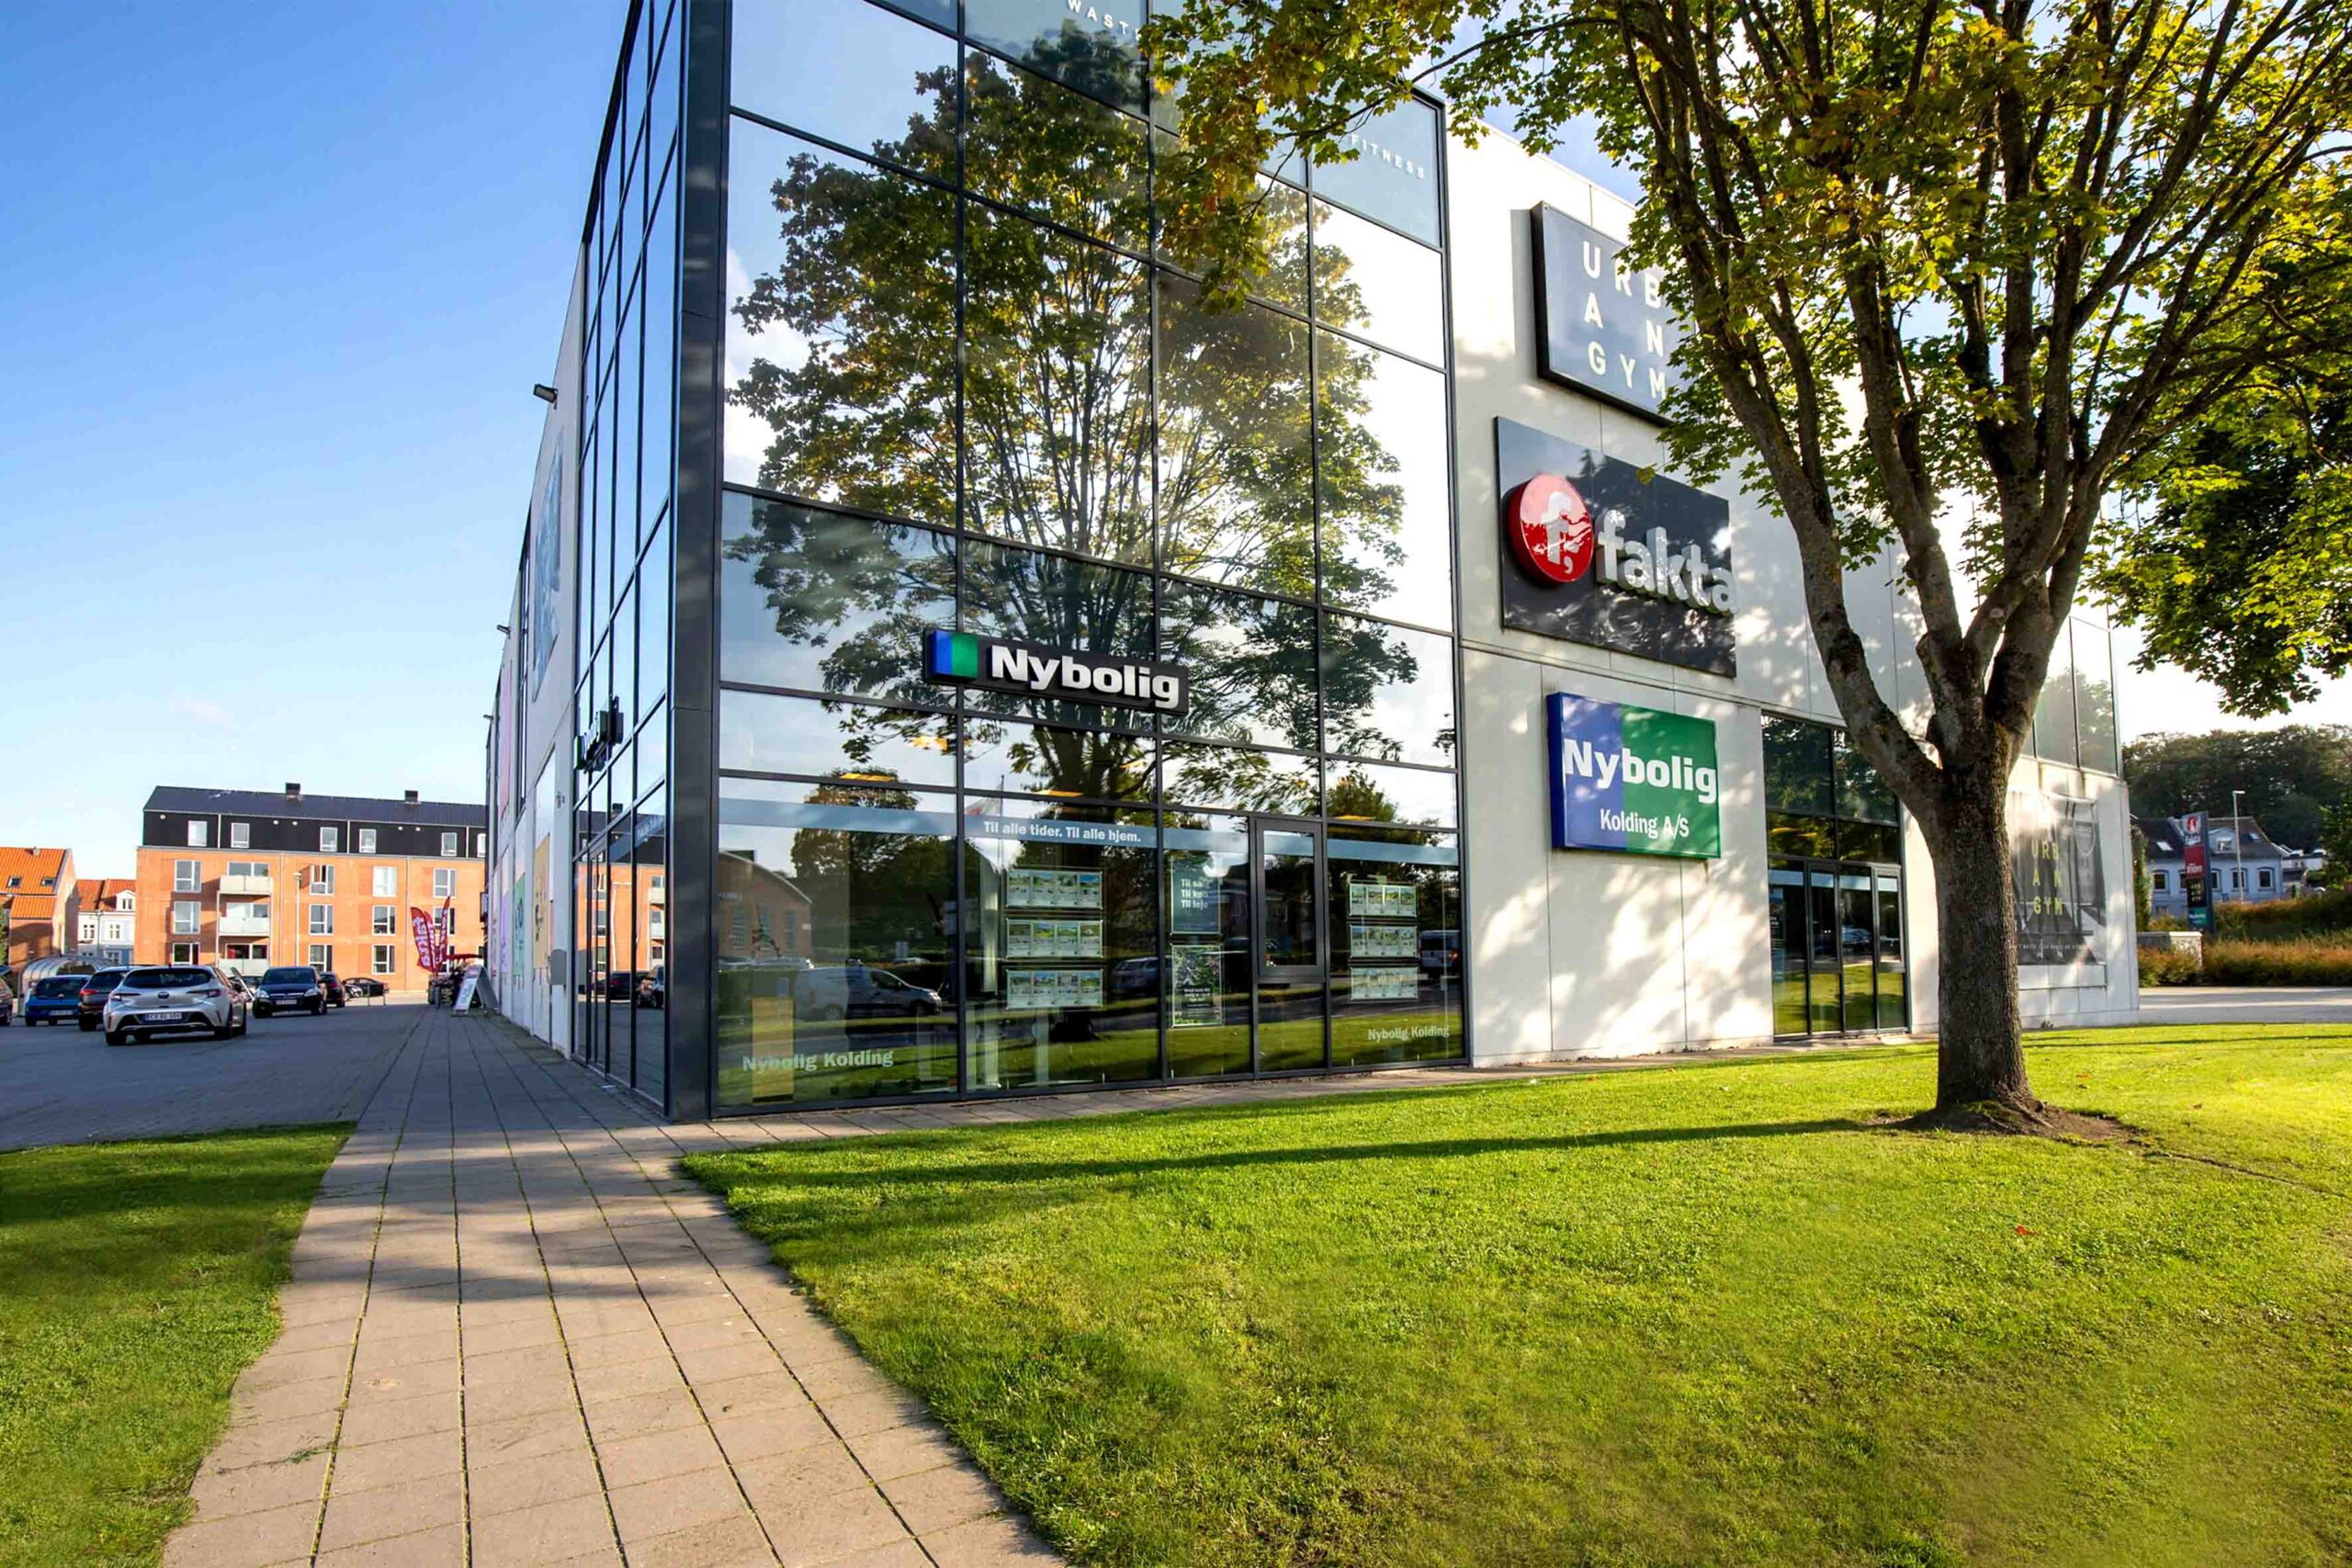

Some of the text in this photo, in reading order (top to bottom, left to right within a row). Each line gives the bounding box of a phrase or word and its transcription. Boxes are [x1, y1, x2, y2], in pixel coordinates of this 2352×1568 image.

[1351, 133, 1424, 179] FITNESS
[1596, 509, 1736, 615] fakta
[991, 645, 1180, 710] Nybolig
[1564, 738, 1716, 805] Nybolig
[983, 821, 1141, 842] Til alle tider. Til alle hjem.
[1600, 808, 1690, 840] Kolding A/S
[1368, 1025, 1450, 1043] Nybolig Kolding
[742, 1050, 894, 1072] Nybolig Kolding
